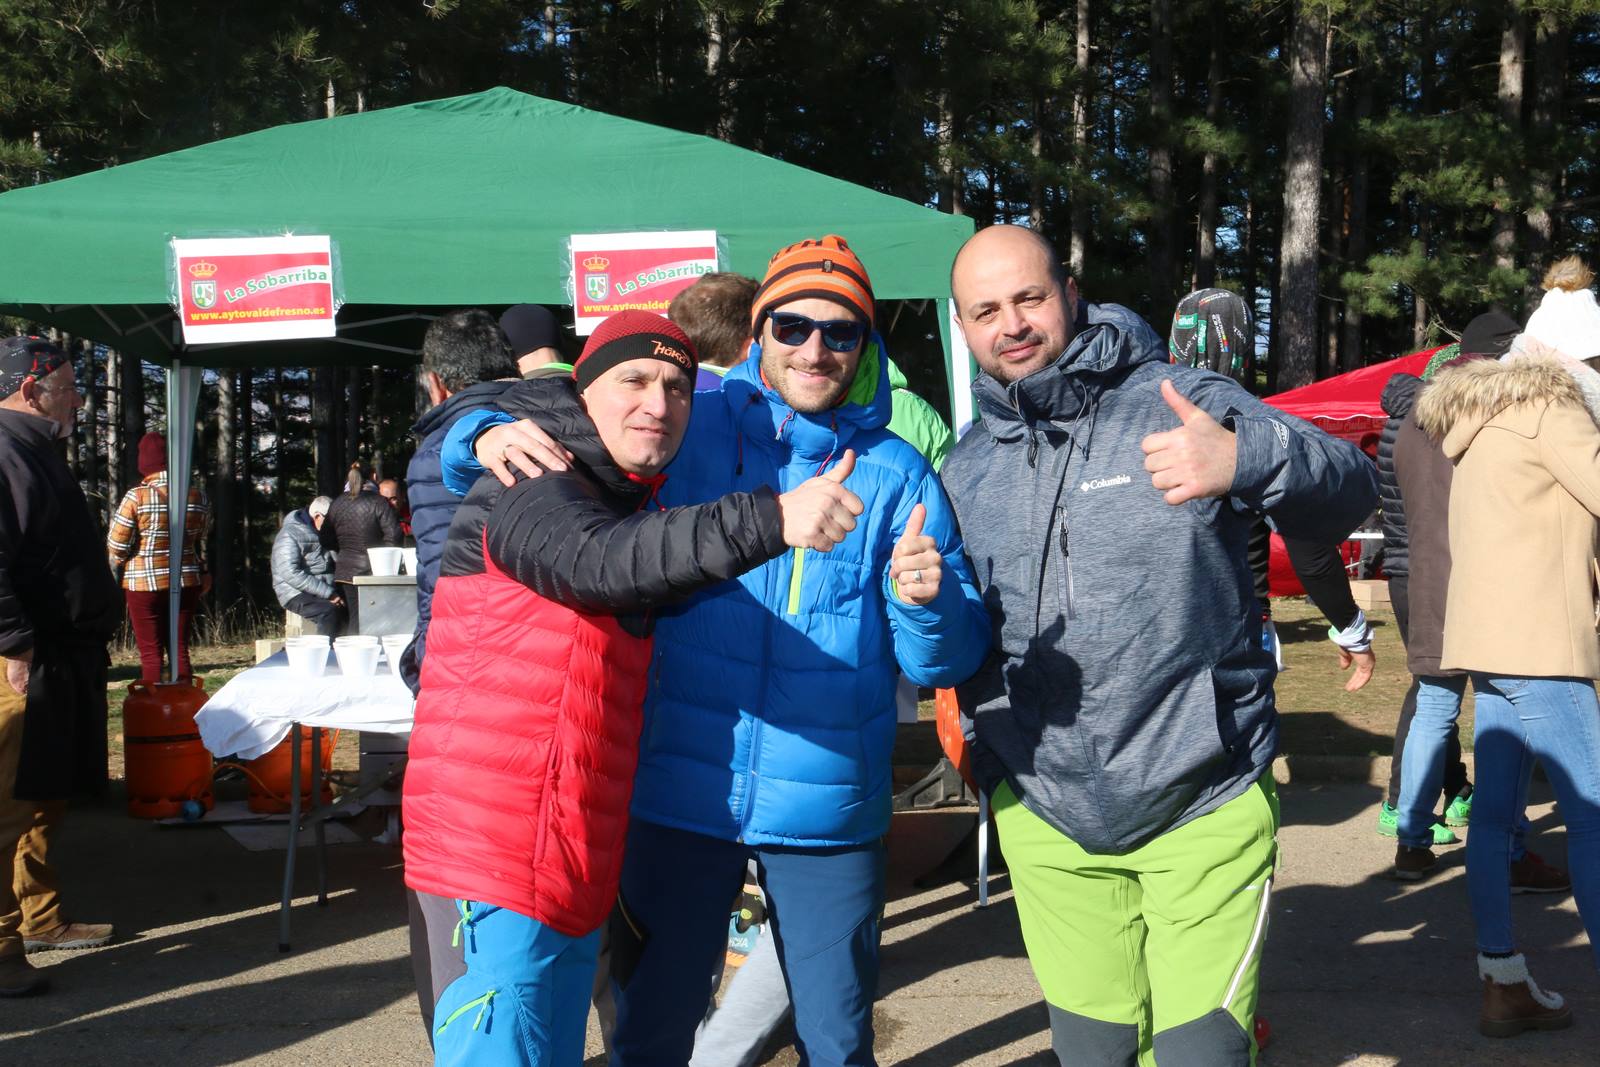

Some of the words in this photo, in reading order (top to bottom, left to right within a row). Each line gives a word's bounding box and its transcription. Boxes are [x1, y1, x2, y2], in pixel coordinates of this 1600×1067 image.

[224, 287, 245, 301] La
[246, 268, 328, 292] Sobarriba
[616, 281, 637, 295] La
[637, 263, 714, 287] Sobarriba
[190, 306, 326, 321] www.aytovaldefresno.es
[583, 300, 671, 312] www.aytovaldef
[1089, 474, 1132, 490] Columbia
